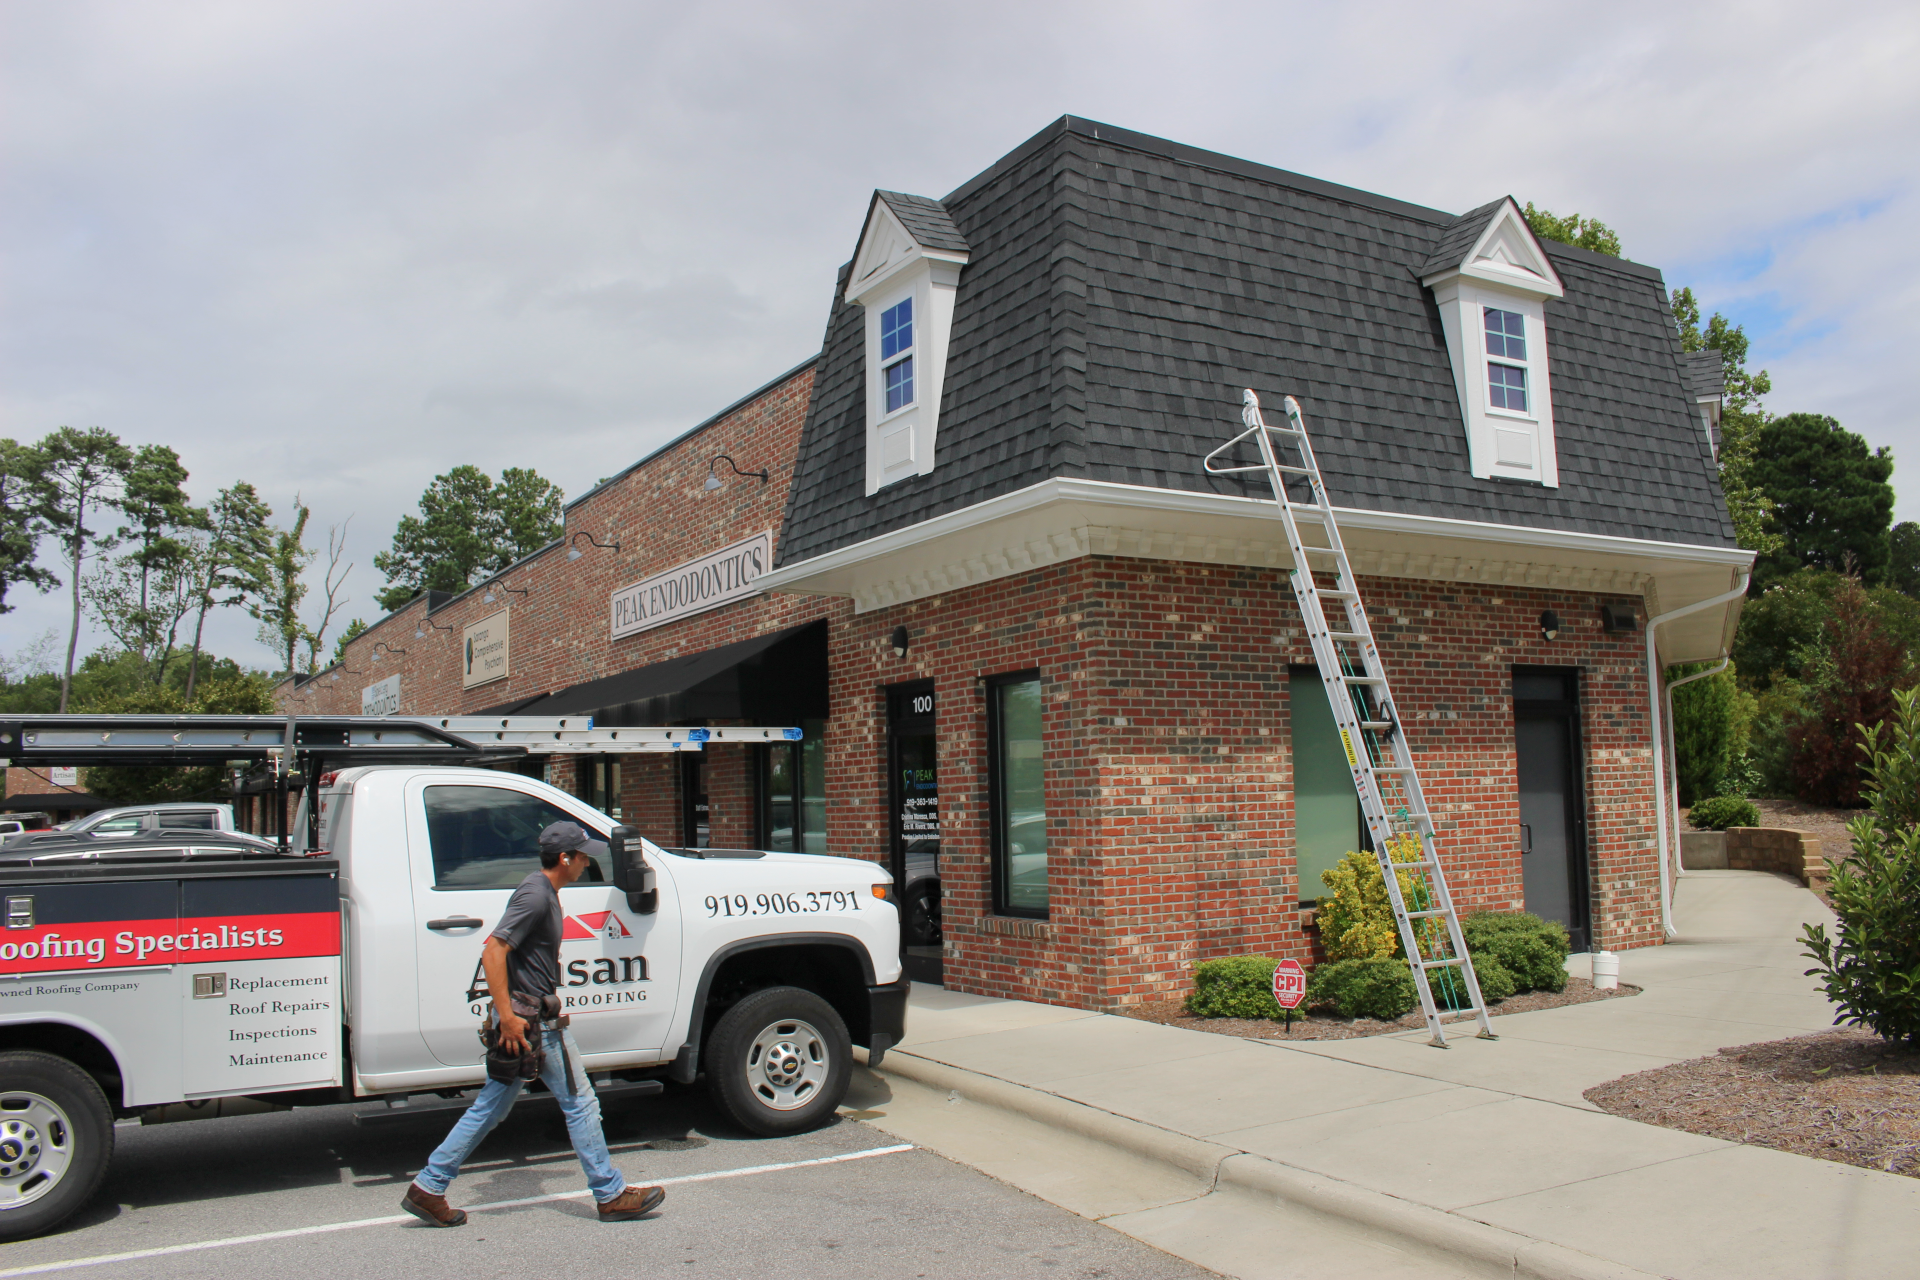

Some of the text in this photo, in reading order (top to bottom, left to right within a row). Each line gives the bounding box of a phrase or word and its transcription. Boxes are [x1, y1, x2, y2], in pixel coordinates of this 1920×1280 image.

[615, 546, 762, 629] PEAK ENDODONTICS
[474, 639, 504, 659] Comprehensive
[485, 655, 504, 672] Psychiatry
[912, 695, 932, 713] 100
[915, 769, 934, 781] PEAK
[704, 890, 863, 918] 919.906.3791
[116, 925, 284, 961] Specialists
[229, 976, 329, 993] Replacement
[466, 953, 653, 998] Aisan
[1275, 975, 1303, 991] CPI
[35, 984, 82, 996] Roofing
[84, 982, 141, 992] Company
[229, 998, 330, 1016] Roof Repairs
[565, 990, 648, 1008] ROOFING
[228, 1025, 317, 1043] Inspections
[228, 1051, 328, 1067] Maintenance
